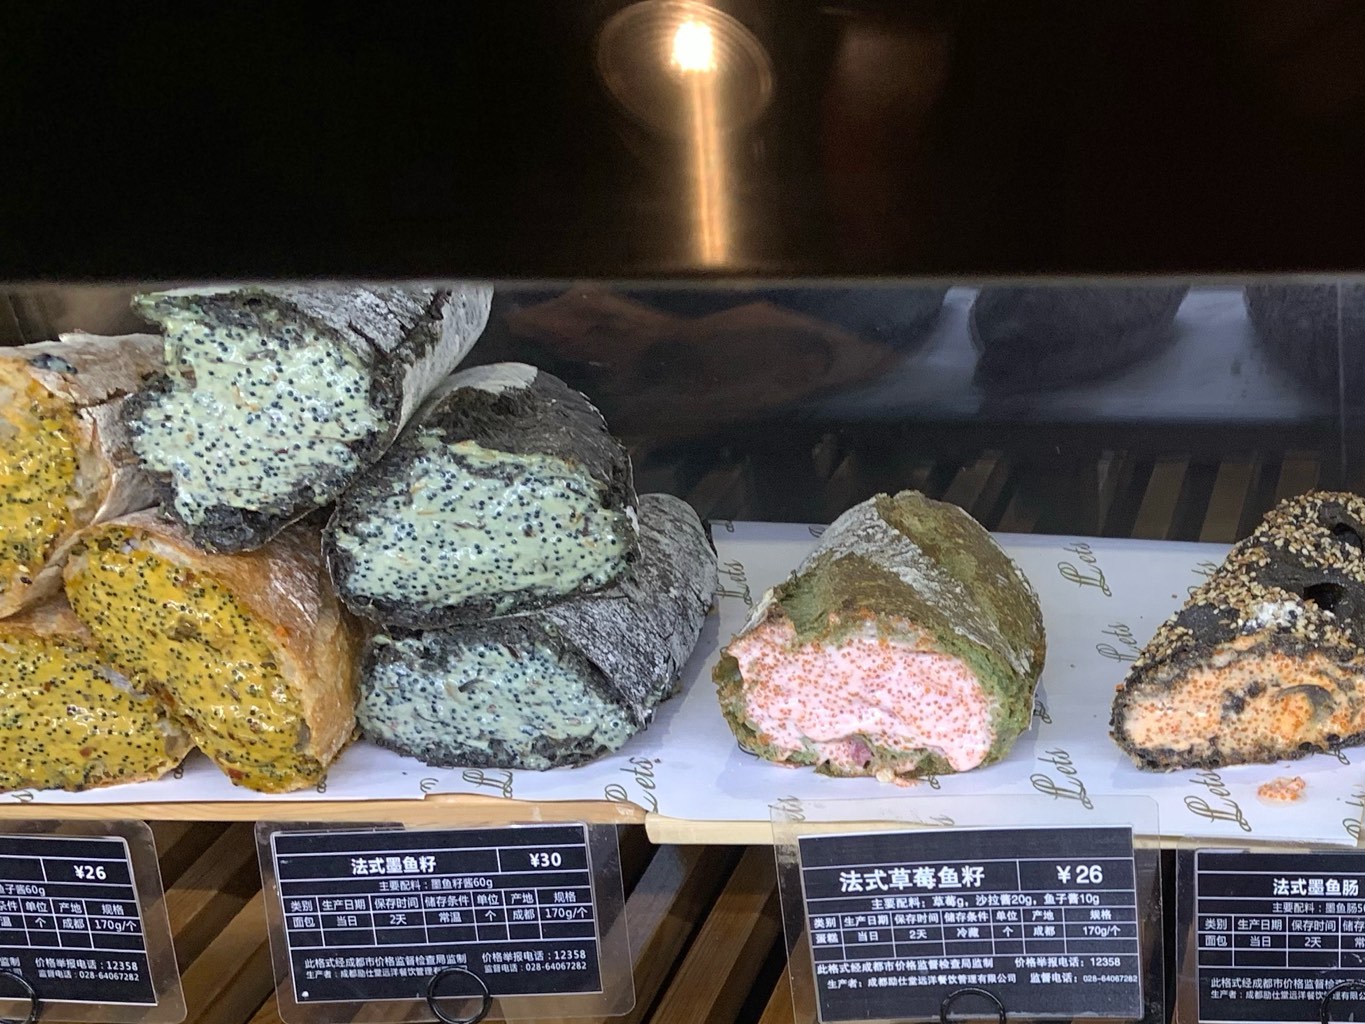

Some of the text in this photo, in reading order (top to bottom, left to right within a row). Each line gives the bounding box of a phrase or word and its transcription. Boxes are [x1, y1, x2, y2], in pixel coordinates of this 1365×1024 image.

[350, 854, 437, 875] 法式墨鱼籽
[529, 851, 562, 867] ¥30
[73, 864, 107, 880] ¥26
[837, 864, 986, 892] 法式草莓鱼籽
[1056, 864, 1103, 884] ¥26
[1273, 877, 1358, 896] 法式墨鱼肠
[24, 900, 124, 915] 单位 产地 规格
[289, 890, 576, 912] 类别 生产日期 保存时间 储存条件 单位 产地 规格
[33, 916, 138, 933] 个 成都 170g/个
[292, 906, 588, 928] 面包 当日 2天 常温 个 成都 170g/个
[812, 908, 1112, 928] 类别 生产日期 保存时间 储存条件 单位 产地 规格
[1204, 917, 1227, 930] 类别
[1237, 918, 1282, 930] 生产日期
[1291, 919, 1336, 932] 保存时间
[814, 924, 1121, 944] 蛋糕 当日 2天 冷藏 个 成都 170g/个
[1204, 934, 1227, 946] 面包
[1249, 935, 1271, 947] 当日
[1304, 936, 1321, 948] 2天
